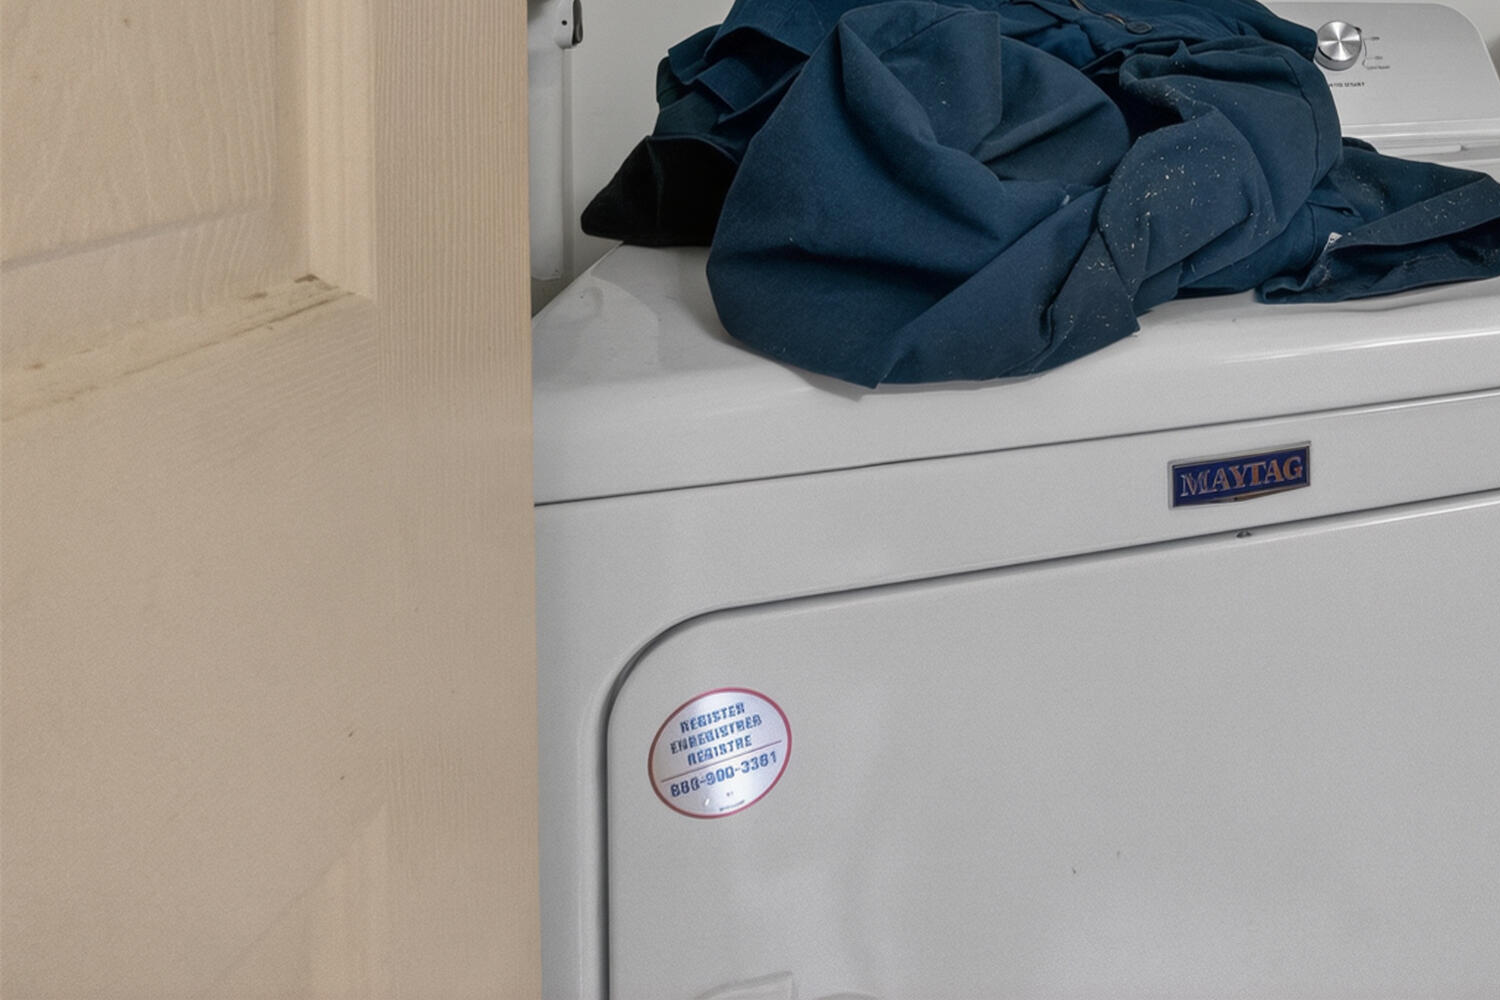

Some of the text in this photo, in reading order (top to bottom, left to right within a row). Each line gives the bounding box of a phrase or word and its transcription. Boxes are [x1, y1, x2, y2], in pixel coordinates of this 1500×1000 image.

[1179, 456, 1303, 497] MAYTAG
[670, 713, 763, 755] ENREGISTRER
[680, 702, 745, 733] REGISTER
[687, 734, 753, 766] REGISTRE
